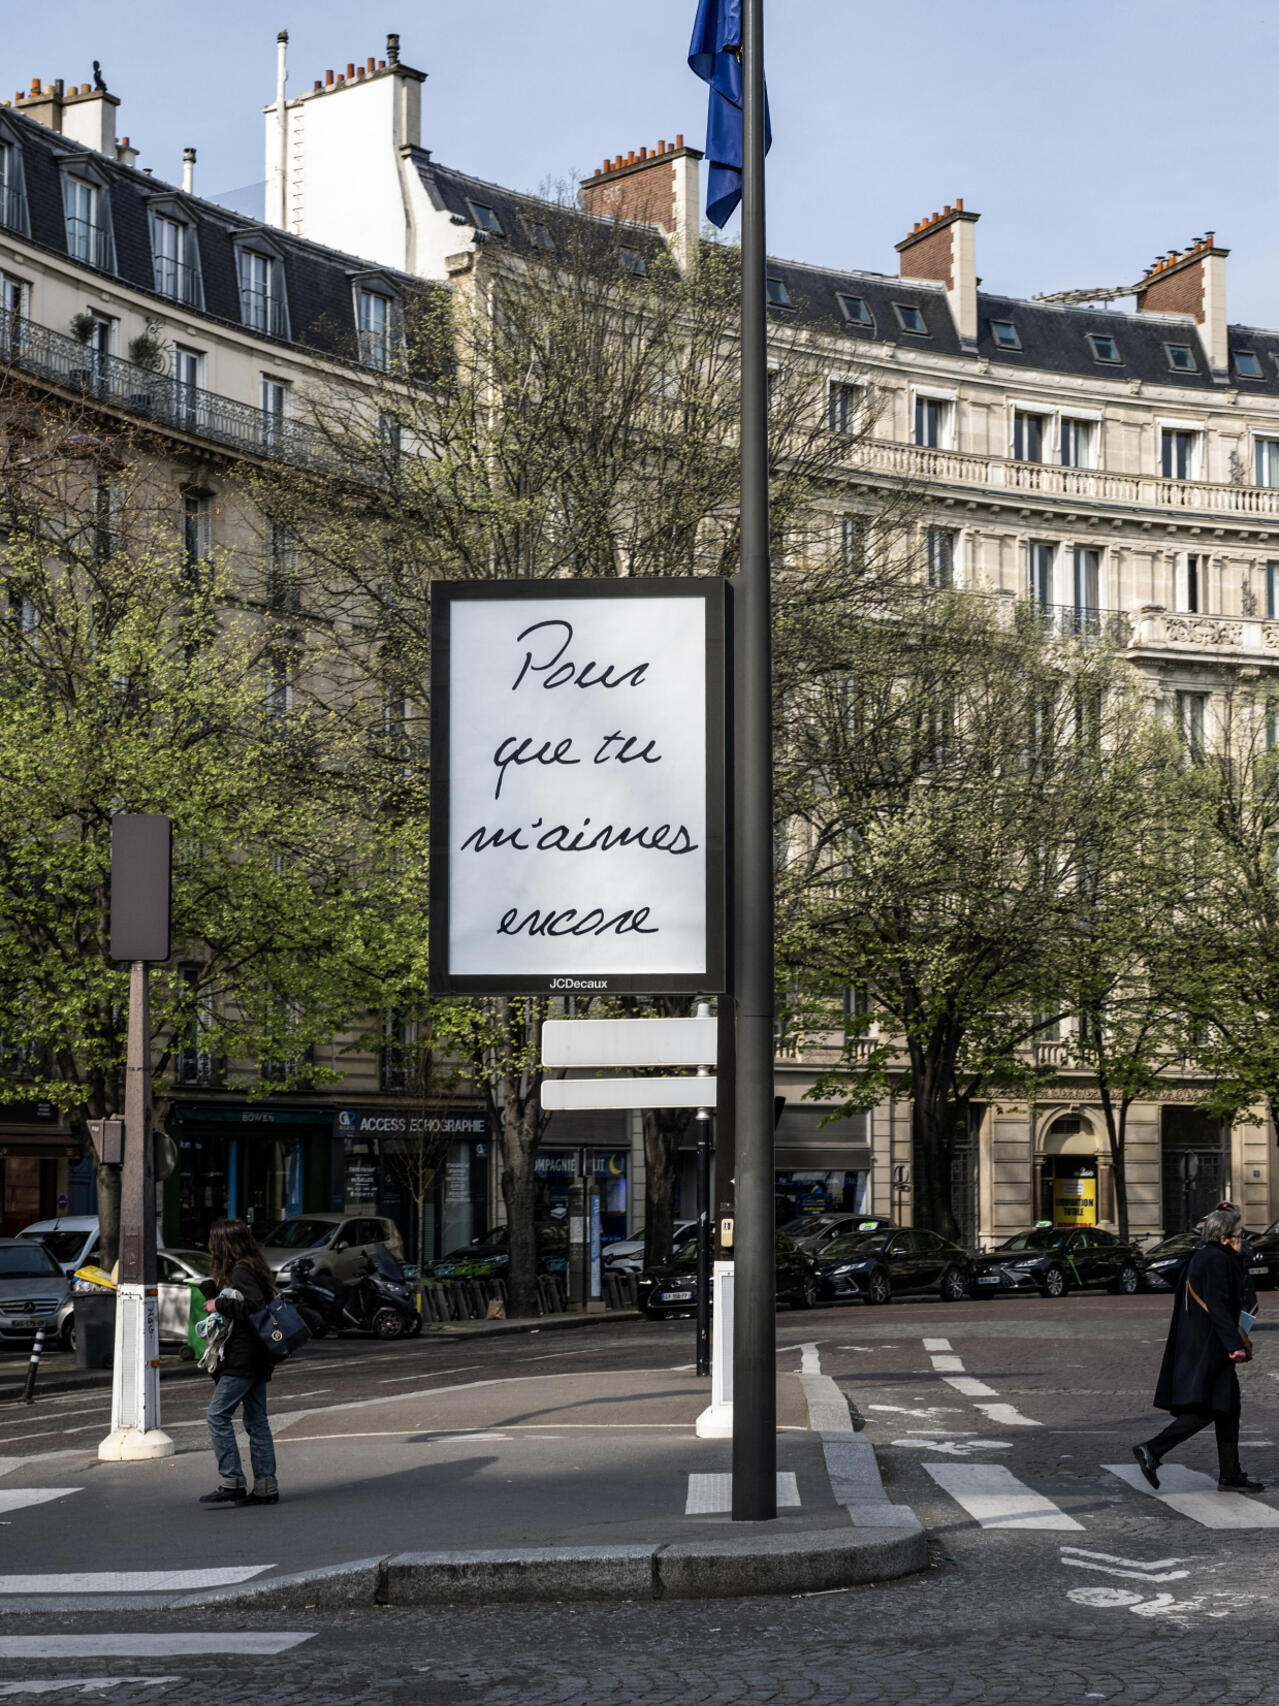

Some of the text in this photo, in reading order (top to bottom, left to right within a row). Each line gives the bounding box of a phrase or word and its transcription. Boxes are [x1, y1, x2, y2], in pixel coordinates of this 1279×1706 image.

[512, 619, 650, 690] Pour
[493, 729, 662, 801] que tu
[460, 817, 699, 855] m'aimes
[496, 906, 660, 937] encore
[549, 978, 608, 989] JCDecaux
[360, 1118, 485, 1133] ACCESS ECHOGRAPHIE
[534, 1158, 577, 1172] MPAGNIE
